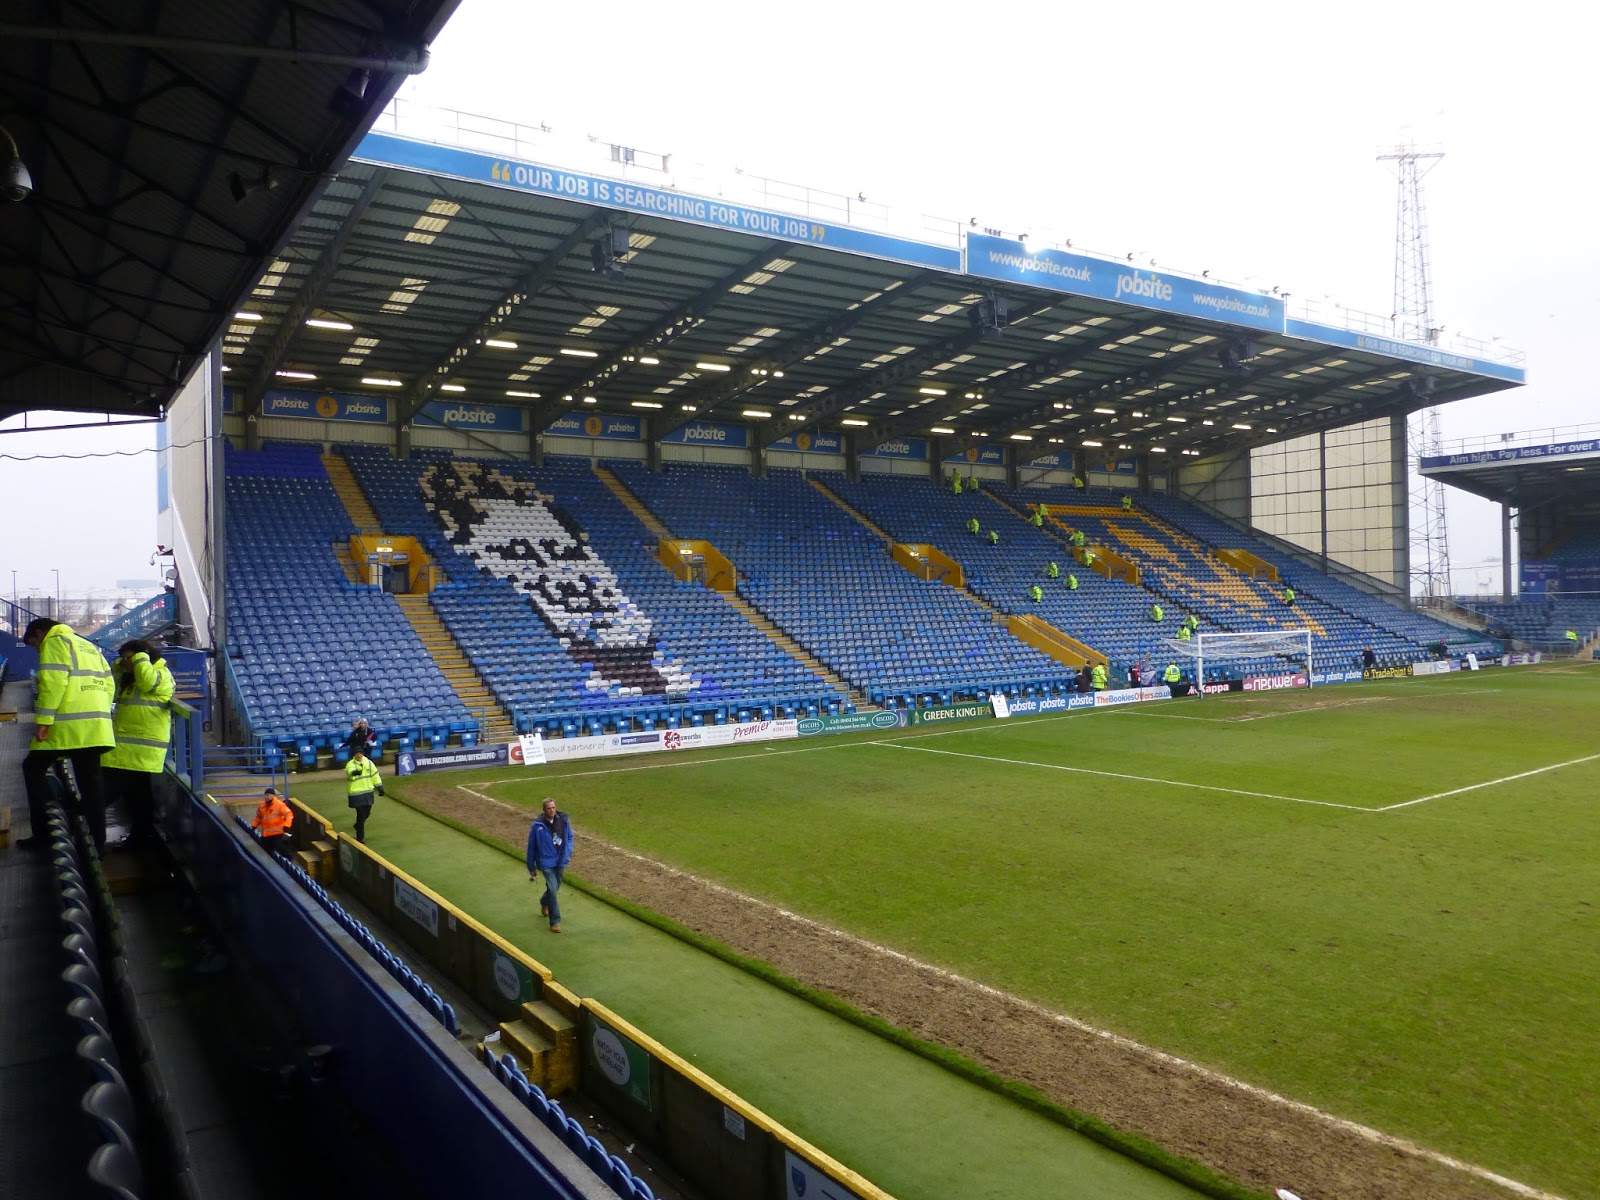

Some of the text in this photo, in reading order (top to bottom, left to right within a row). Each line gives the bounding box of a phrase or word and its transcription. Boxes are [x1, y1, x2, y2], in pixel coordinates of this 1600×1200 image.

[556, 174, 589, 197] JOB
[593, 182, 611, 201] IS
[614, 185, 706, 220] SEARCHING
[709, 204, 739, 228] FOR
[741, 211, 781, 234] YOUR
[989, 250, 1092, 283] www.jobsite.co.uk
[1114, 270, 1173, 301] jobsite
[1192, 292, 1271, 319] www.jobsite.co.uk
[272, 397, 309, 410] jobsite
[345, 403, 381, 415] jobsite
[443, 405, 496, 424] jobsite
[607, 422, 636, 434] jobsite
[684, 425, 726, 442] jobsite
[815, 437, 837, 448] jobsite
[1449, 455, 1469, 464] Aim
[1471, 452, 1496, 463] high.
[1499, 450, 1517, 460] Pay
[1520, 447, 1545, 457] less.
[1548, 445, 1566, 454] For
[1569, 442, 1594, 451] over
[1371, 667, 1407, 678] TradePoint
[1201, 683, 1230, 694] Kappa
[1253, 675, 1298, 691] npower
[1009, 700, 1037, 715] jobsite
[1039, 697, 1066, 712] jobsite
[1068, 694, 1094, 709] jobsite
[923, 708, 955, 721] GREENE
[956, 707, 976, 717] KING
[977, 705, 992, 716] IPA
[733, 721, 772, 740] Premier
[567, 743, 596, 754] partner
[598, 740, 606, 751] of
